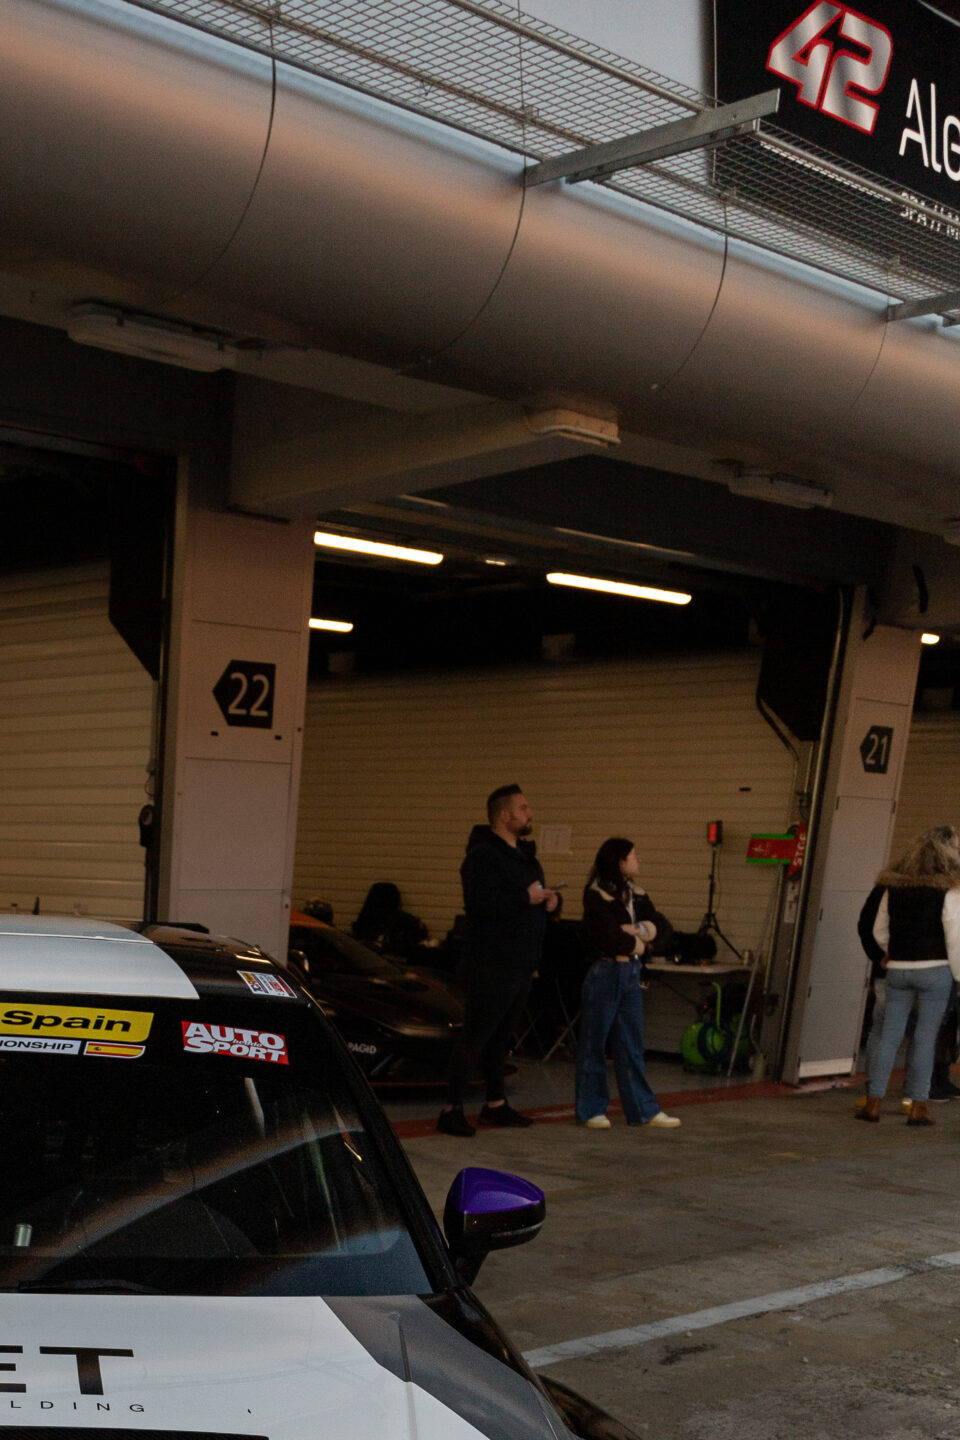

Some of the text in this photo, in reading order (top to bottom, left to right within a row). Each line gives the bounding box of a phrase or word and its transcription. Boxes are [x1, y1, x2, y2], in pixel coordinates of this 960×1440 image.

[766, 0, 893, 135] 42
[227, 672, 270, 717] 22
[865, 733, 889, 766] 21
[1, 1010, 132, 1032] Spain
[184, 1022, 285, 1050] AUTO
[183, 1036, 286, 1062] SPORT
